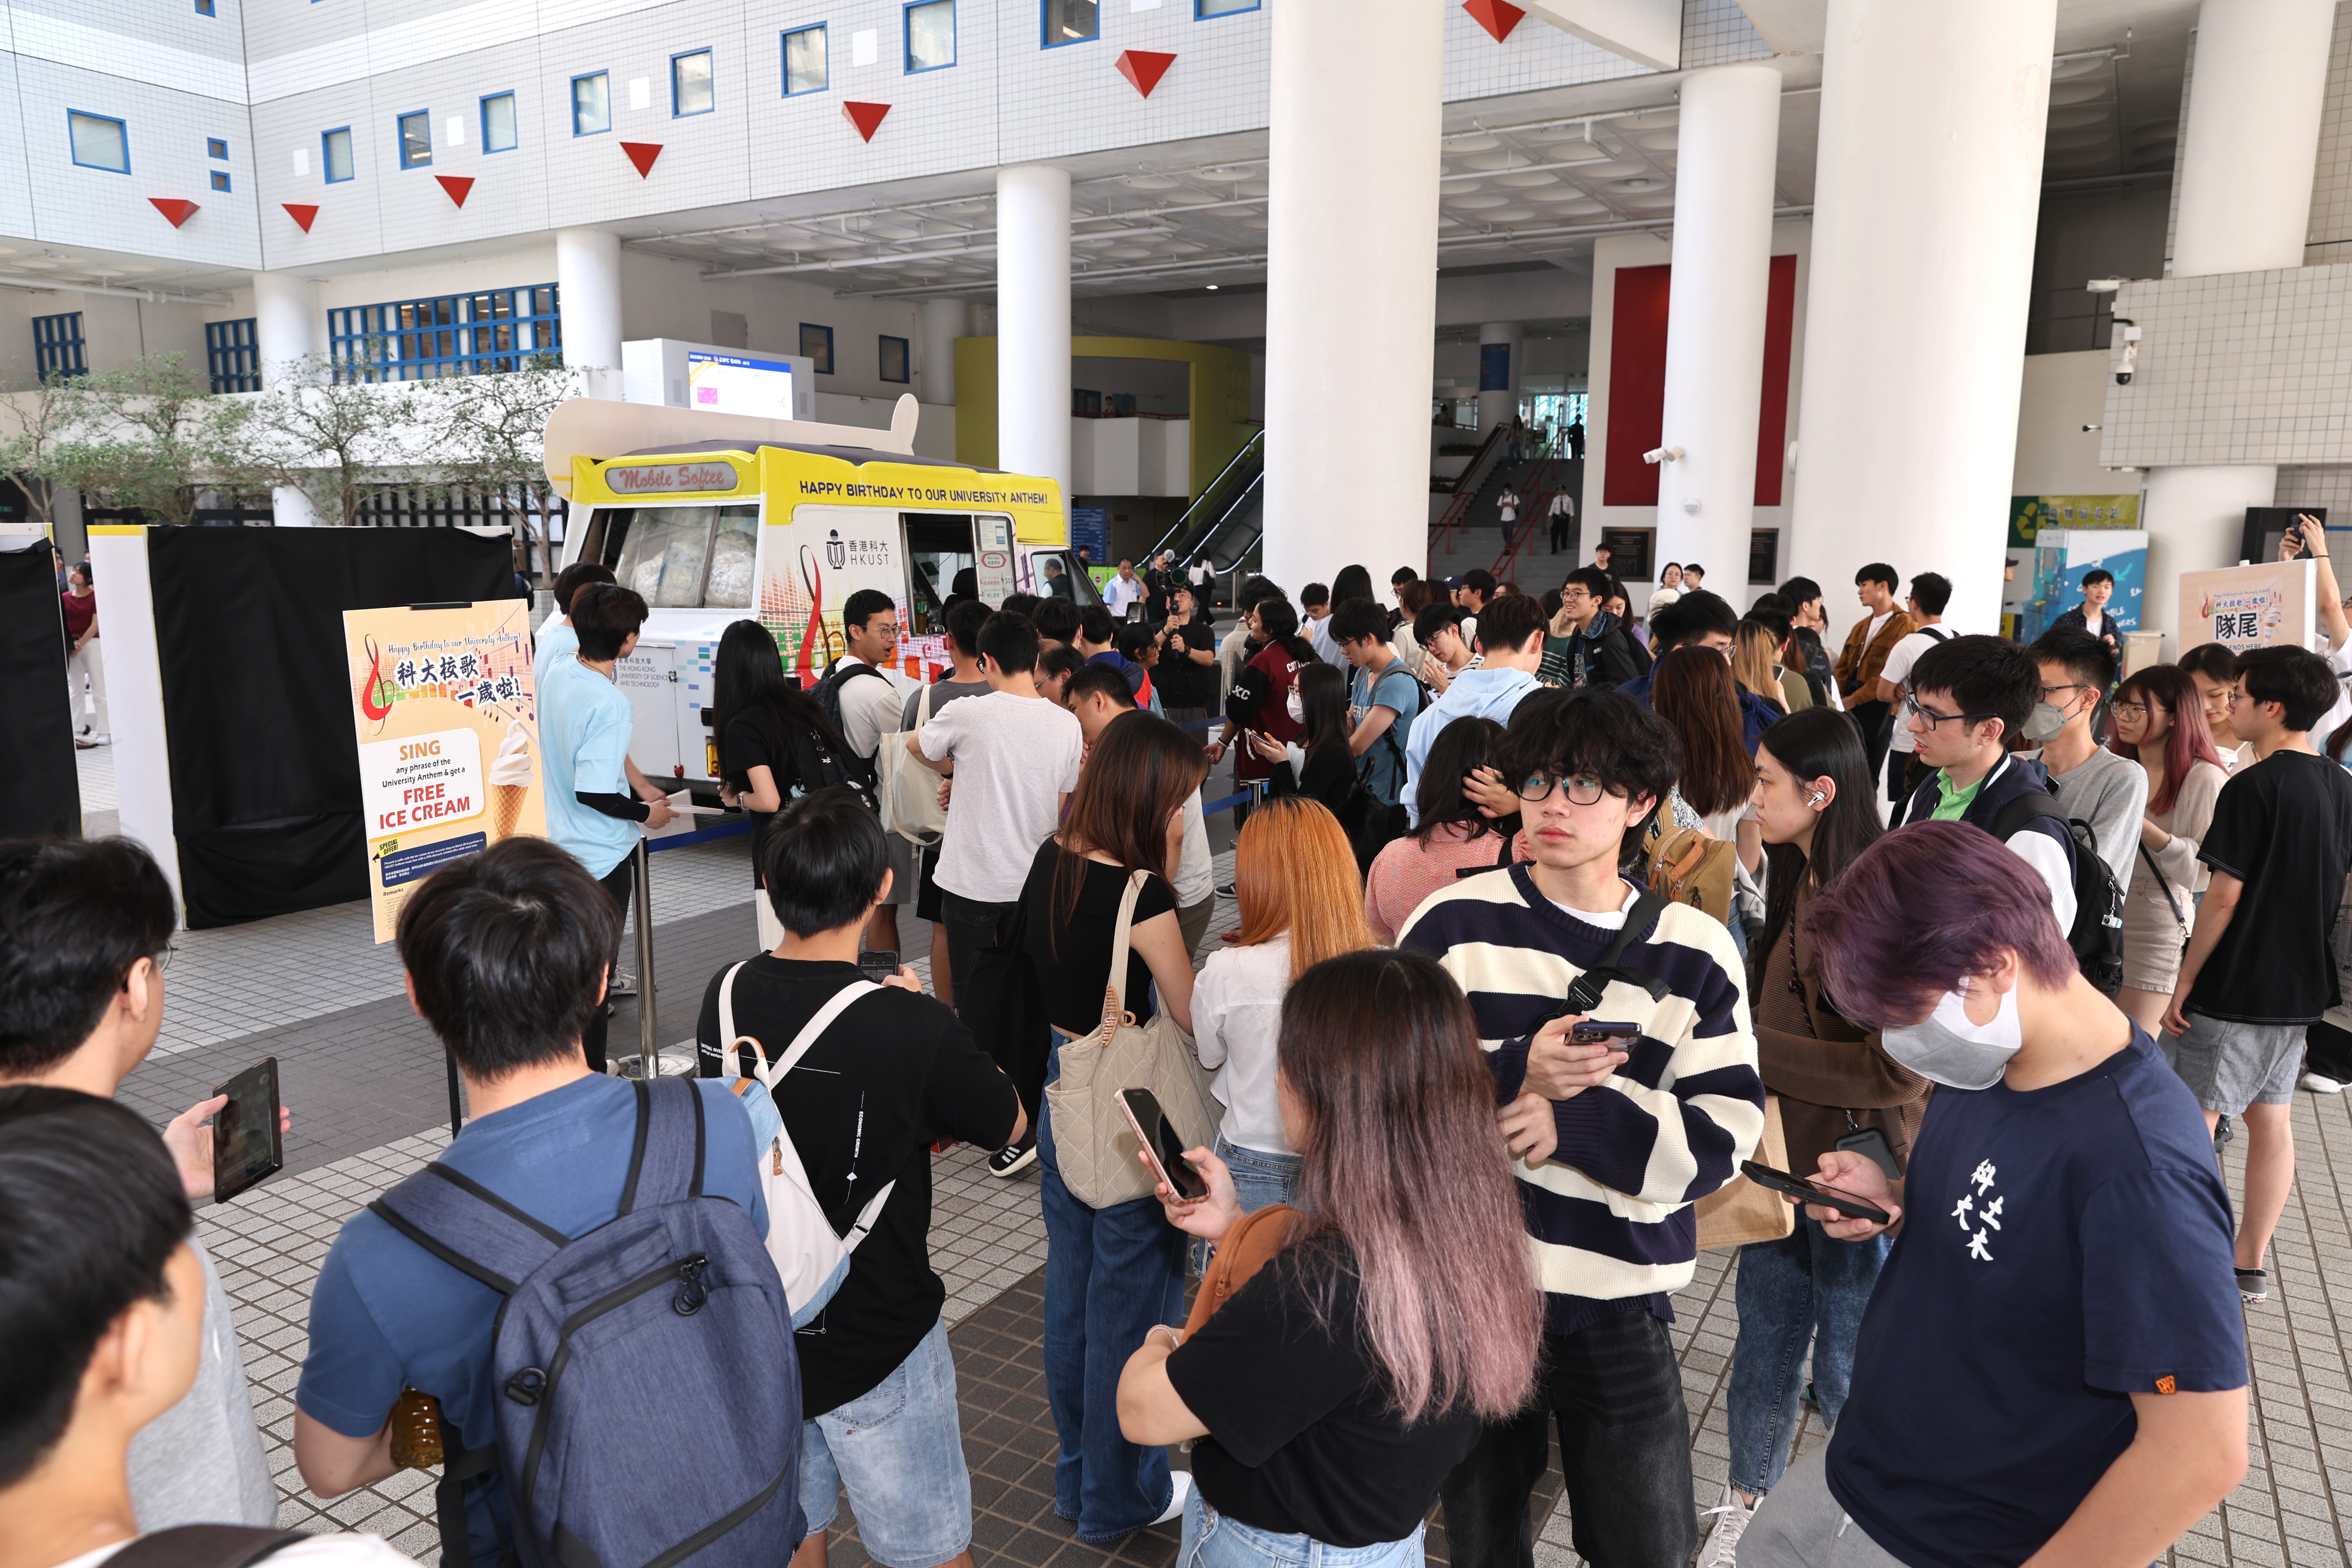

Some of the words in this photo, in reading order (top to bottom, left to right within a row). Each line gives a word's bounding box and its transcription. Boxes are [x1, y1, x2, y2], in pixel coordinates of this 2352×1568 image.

[619, 468, 673, 488] Mobile
[679, 466, 724, 490] Softee
[800, 481, 842, 496] HAPPY
[846, 484, 904, 499] BIRTHDAY
[907, 488, 922, 500] TO
[926, 489, 946, 501] OUR
[950, 490, 1006, 503] UNIVERSITY
[1010, 492, 1048, 505] ANTHEM!
[849, 540, 888, 552] 香港科大
[851, 554, 888, 565] HKUST
[2216, 599, 2242, 608] 科大校歌
[2216, 613, 2258, 639] 隊尾
[388, 645, 410, 656] Happy
[412, 640, 443, 652] Birthday
[444, 639, 450, 648] to
[463, 634, 495, 647] University
[496, 632, 521, 642] Anthem!
[397, 654, 479, 686] 科大校歌
[457, 677, 521, 705] 一歲啦!
[399, 740, 441, 761] SING
[382, 776, 416, 788] University
[417, 771, 443, 781] Anthem
[450, 767, 461, 777] get
[410, 762, 432, 773] phrase
[404, 783, 445, 805] FREE
[379, 809, 407, 829] ICE
[412, 796, 470, 822] CREAM
[379, 838, 398, 850] SPECIAL
[383, 844, 399, 855] OFFER!
[383, 888, 404, 897] Remarks
